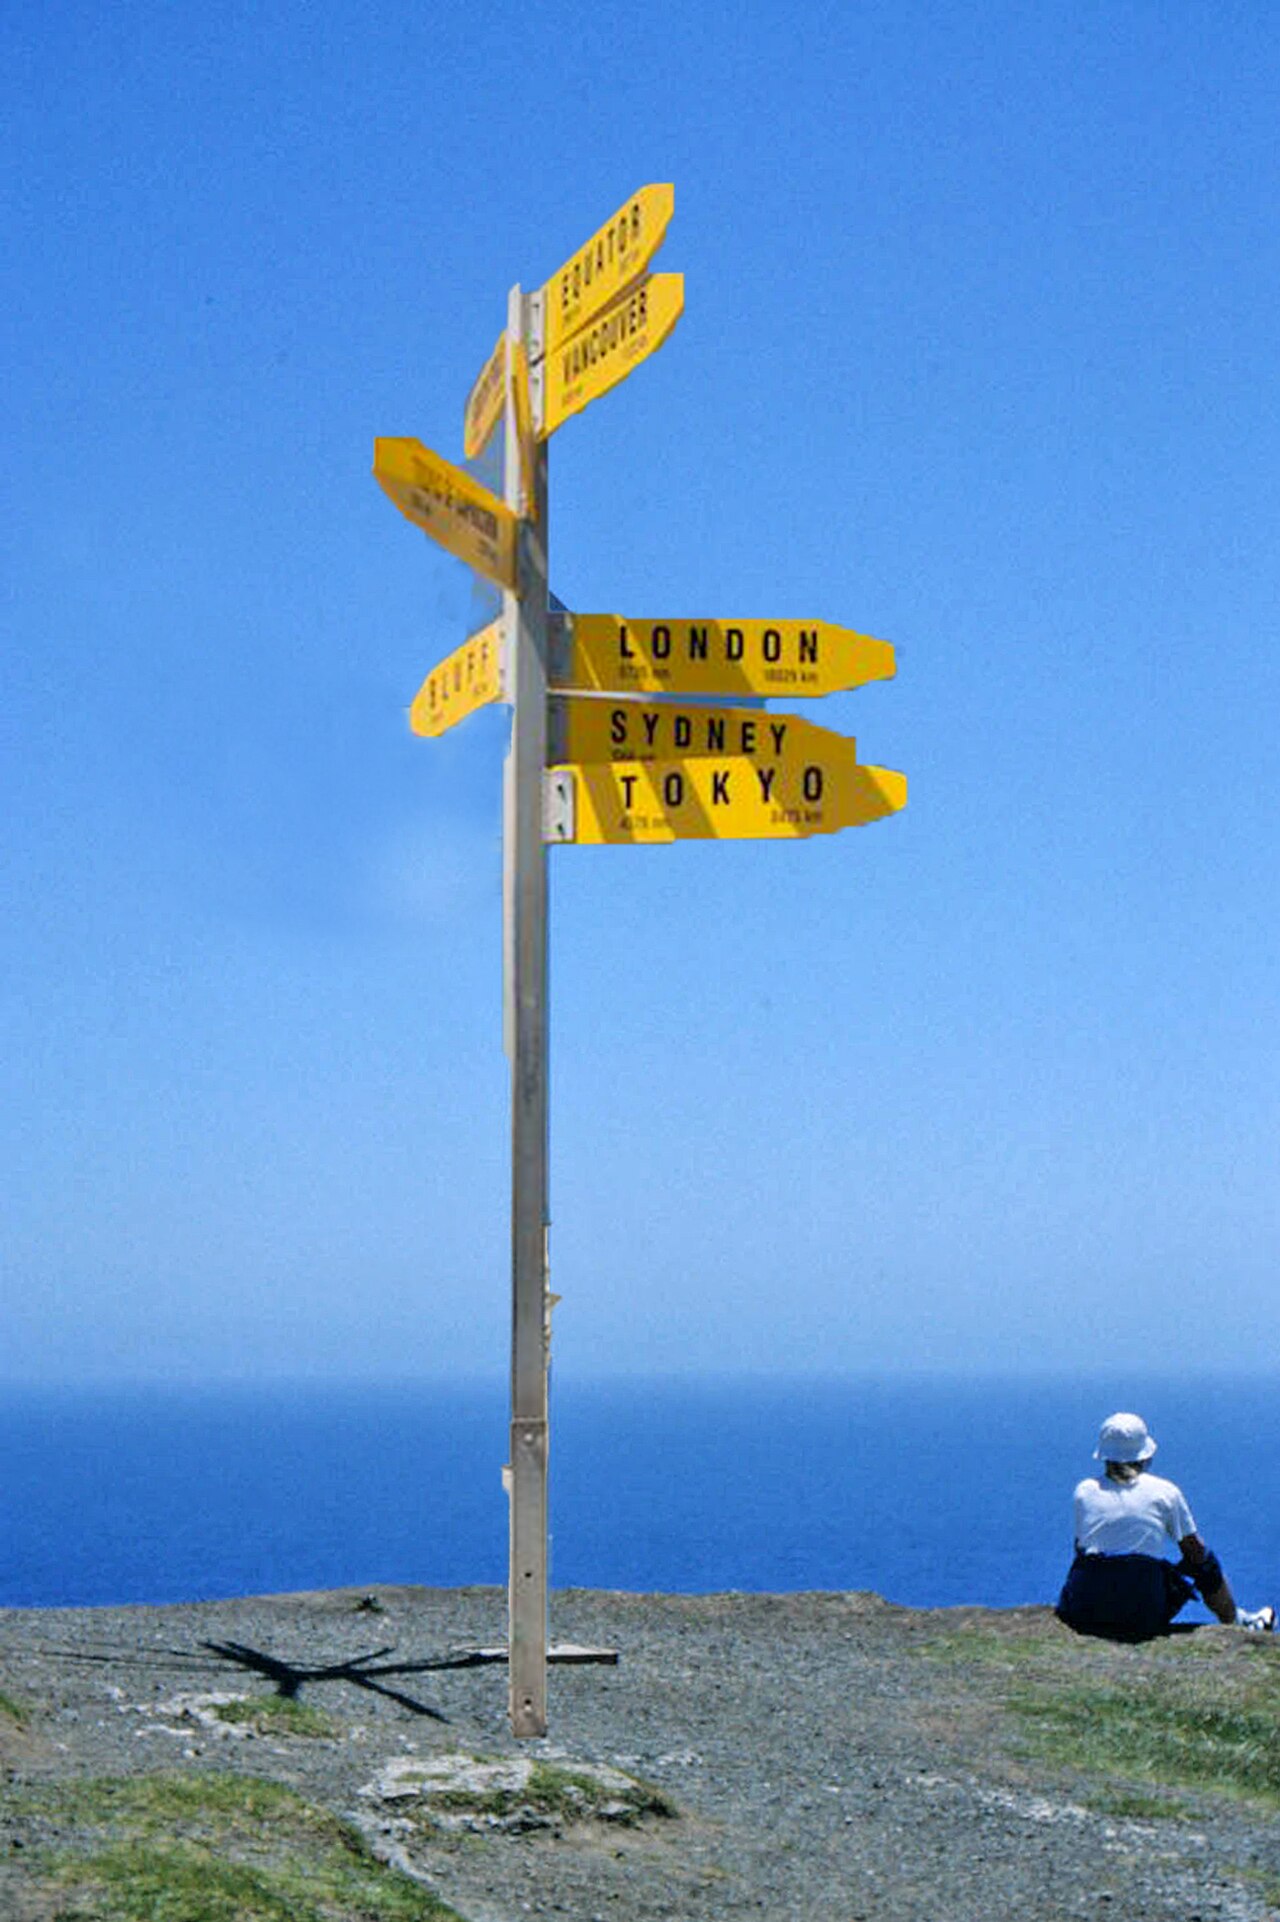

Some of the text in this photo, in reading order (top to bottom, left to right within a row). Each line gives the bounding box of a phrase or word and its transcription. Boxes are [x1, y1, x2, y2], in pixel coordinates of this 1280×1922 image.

[562, 203, 641, 308] EQUATOR
[563, 285, 648, 384] VANCOUVER
[620, 625, 818, 664] LONDON
[429, 641, 488, 711] BLUFF
[611, 709, 787, 756] SYDNEY
[620, 766, 823, 810] TOKYO
